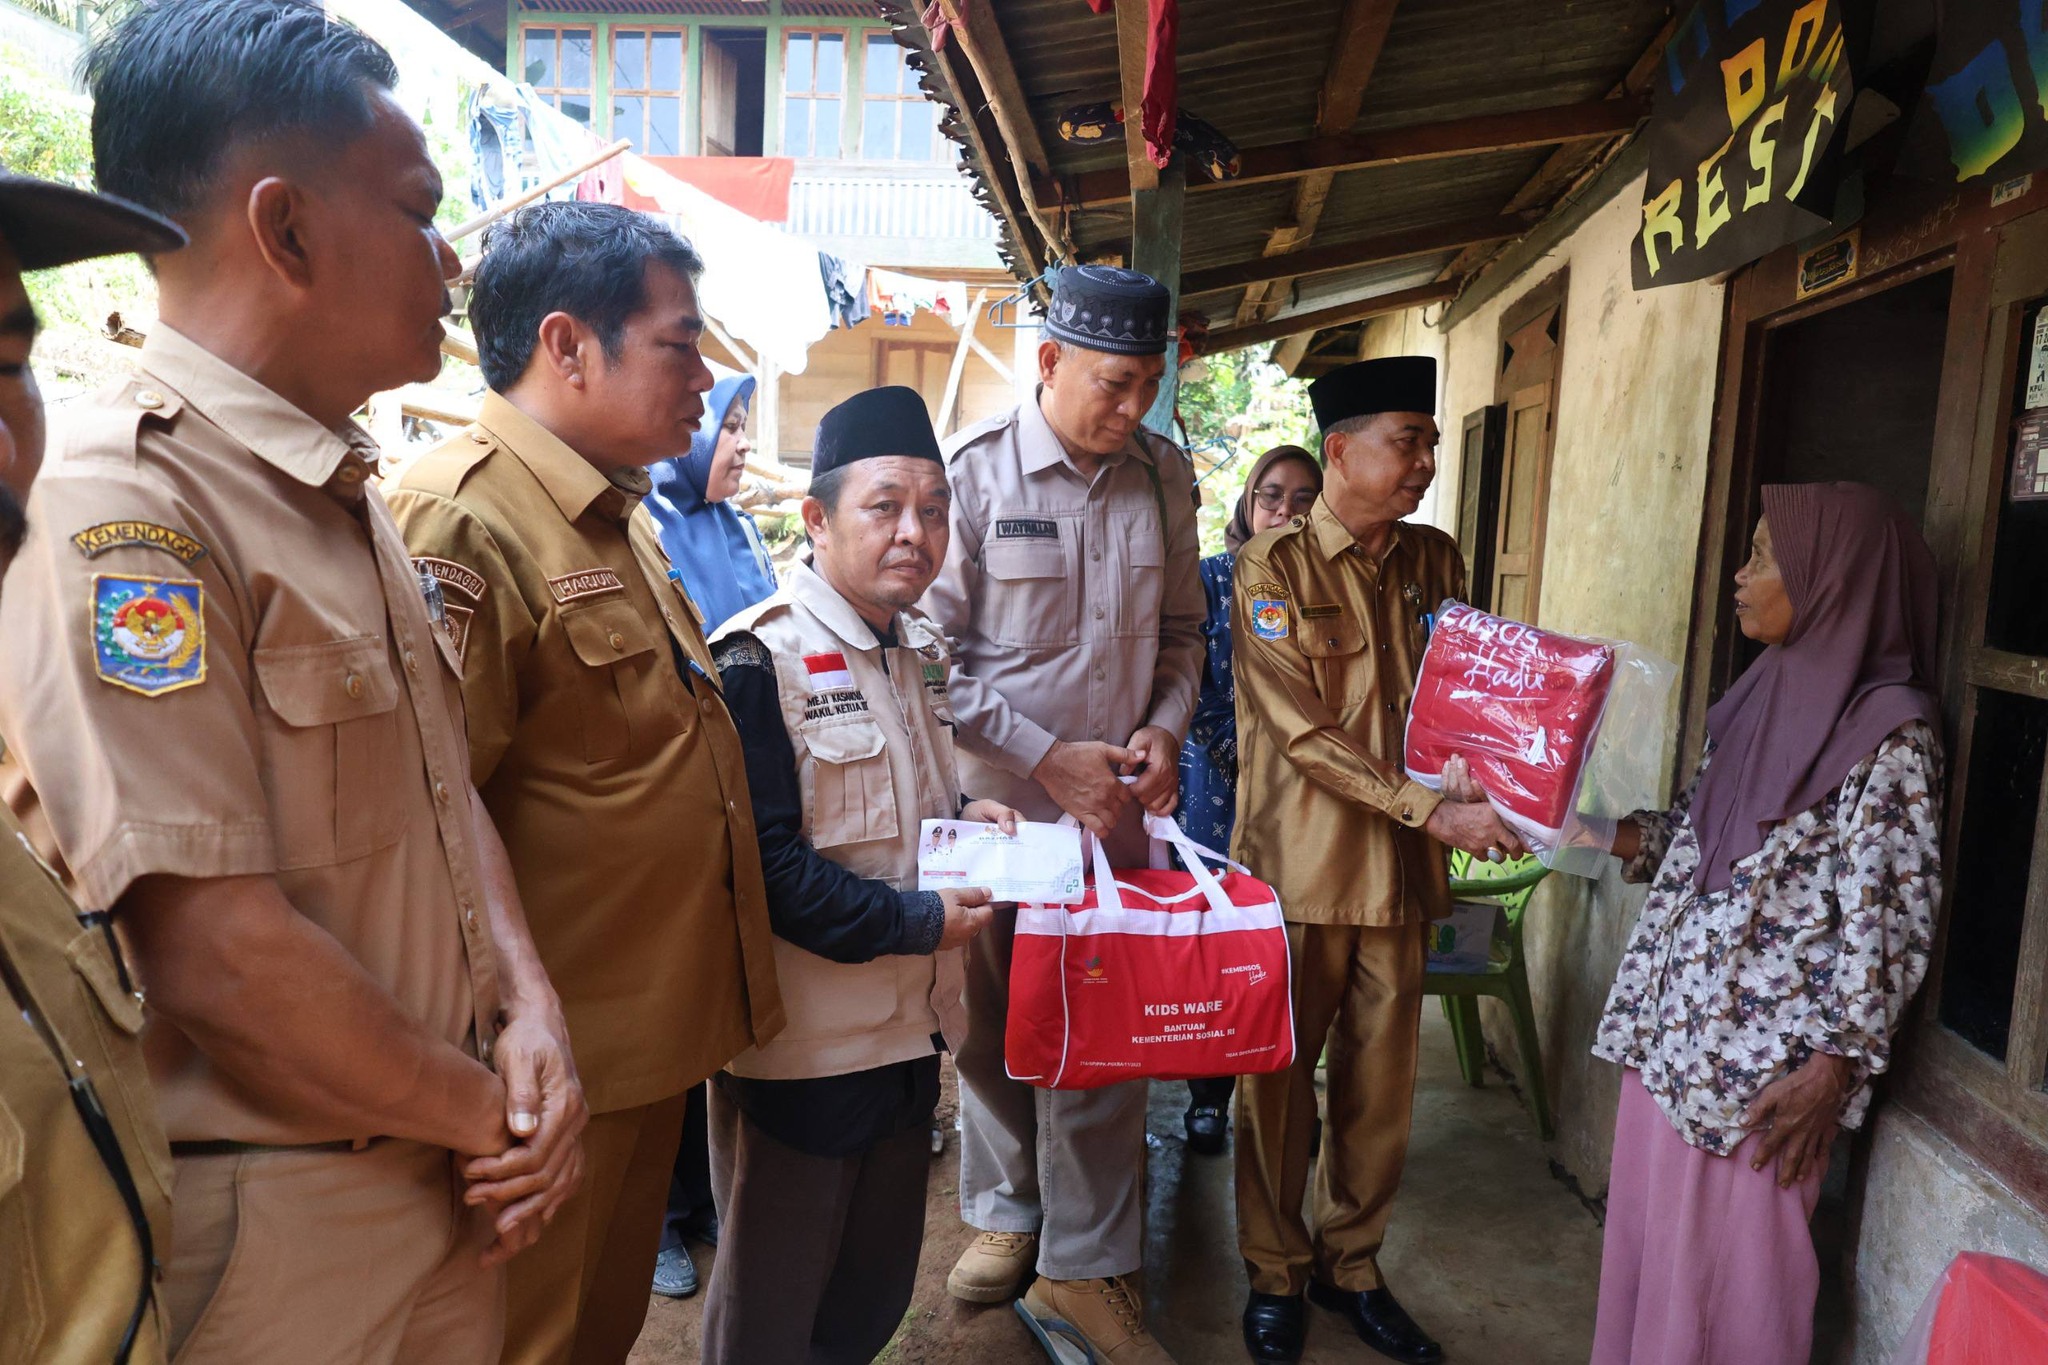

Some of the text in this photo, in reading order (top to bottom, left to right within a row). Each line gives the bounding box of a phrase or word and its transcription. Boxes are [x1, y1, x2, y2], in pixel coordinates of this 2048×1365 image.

[79, 524, 199, 560] KEMENDAGRI
[807, 694, 829, 707] MEJI
[804, 706, 835, 721] WAKIL
[835, 703, 862, 715] KETUA
[1221, 963, 1261, 975] #KEMENSOS
[1144, 1000, 1223, 1016] KIDS WARE
[1131, 1028, 1235, 1044] KEMENTERIAN SOSIAL RI
[1164, 1023, 1206, 1033] BANTUAN
